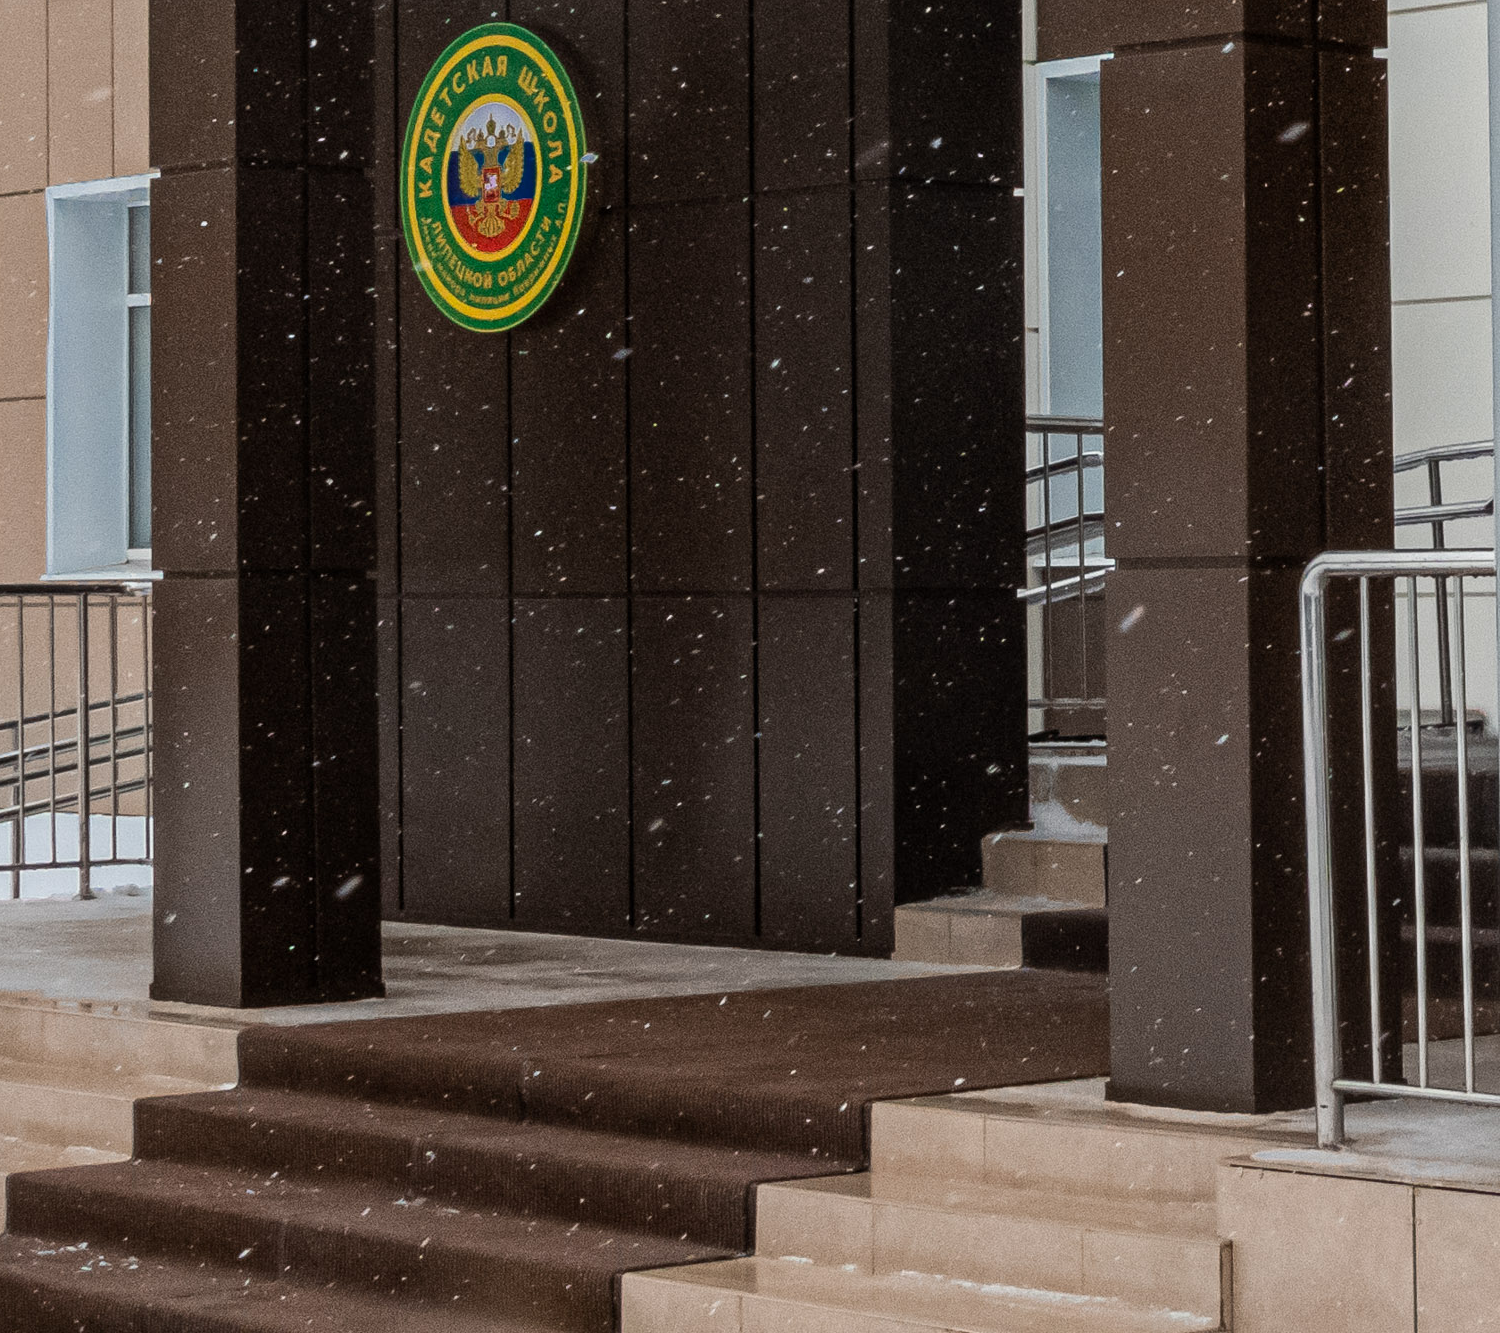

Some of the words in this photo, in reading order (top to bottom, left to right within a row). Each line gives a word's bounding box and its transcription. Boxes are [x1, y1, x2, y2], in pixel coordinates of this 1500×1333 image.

[418, 55, 508, 198] КАДЕТСКАЯ
[517, 66, 564, 184] ШКОЛА
[432, 220, 492, 289] ЛИПЕЦКОЙ
[498, 216, 552, 287] ОБЛАСТИ
